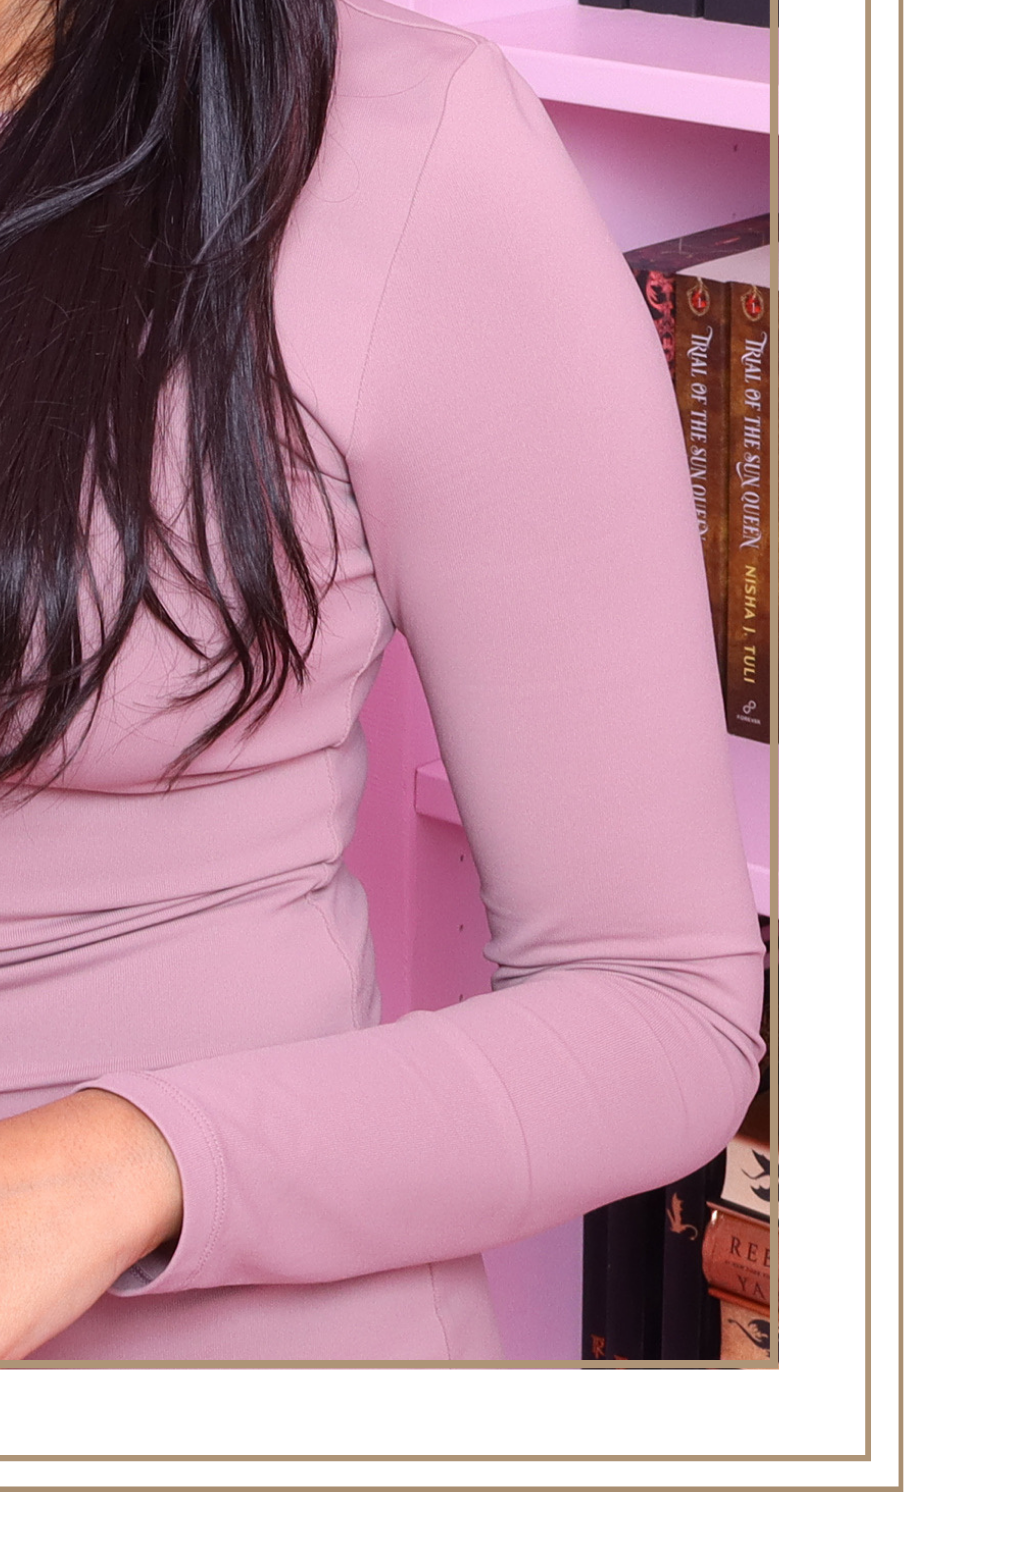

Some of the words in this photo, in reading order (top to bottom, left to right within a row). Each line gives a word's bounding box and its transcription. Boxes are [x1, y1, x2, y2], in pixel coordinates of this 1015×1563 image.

[687, 326, 713, 377] TRIAL
[741, 331, 767, 383] TRIAL
[691, 382, 707, 405] OF
[744, 388, 761, 411] OF
[690, 411, 707, 443] THE
[744, 416, 761, 450] THE
[690, 445, 707, 480] SUN
[736, 451, 761, 488] SUN
[740, 491, 762, 550] QUEEN
[744, 565, 757, 619] NISHA
[744, 645, 756, 683] TULI
